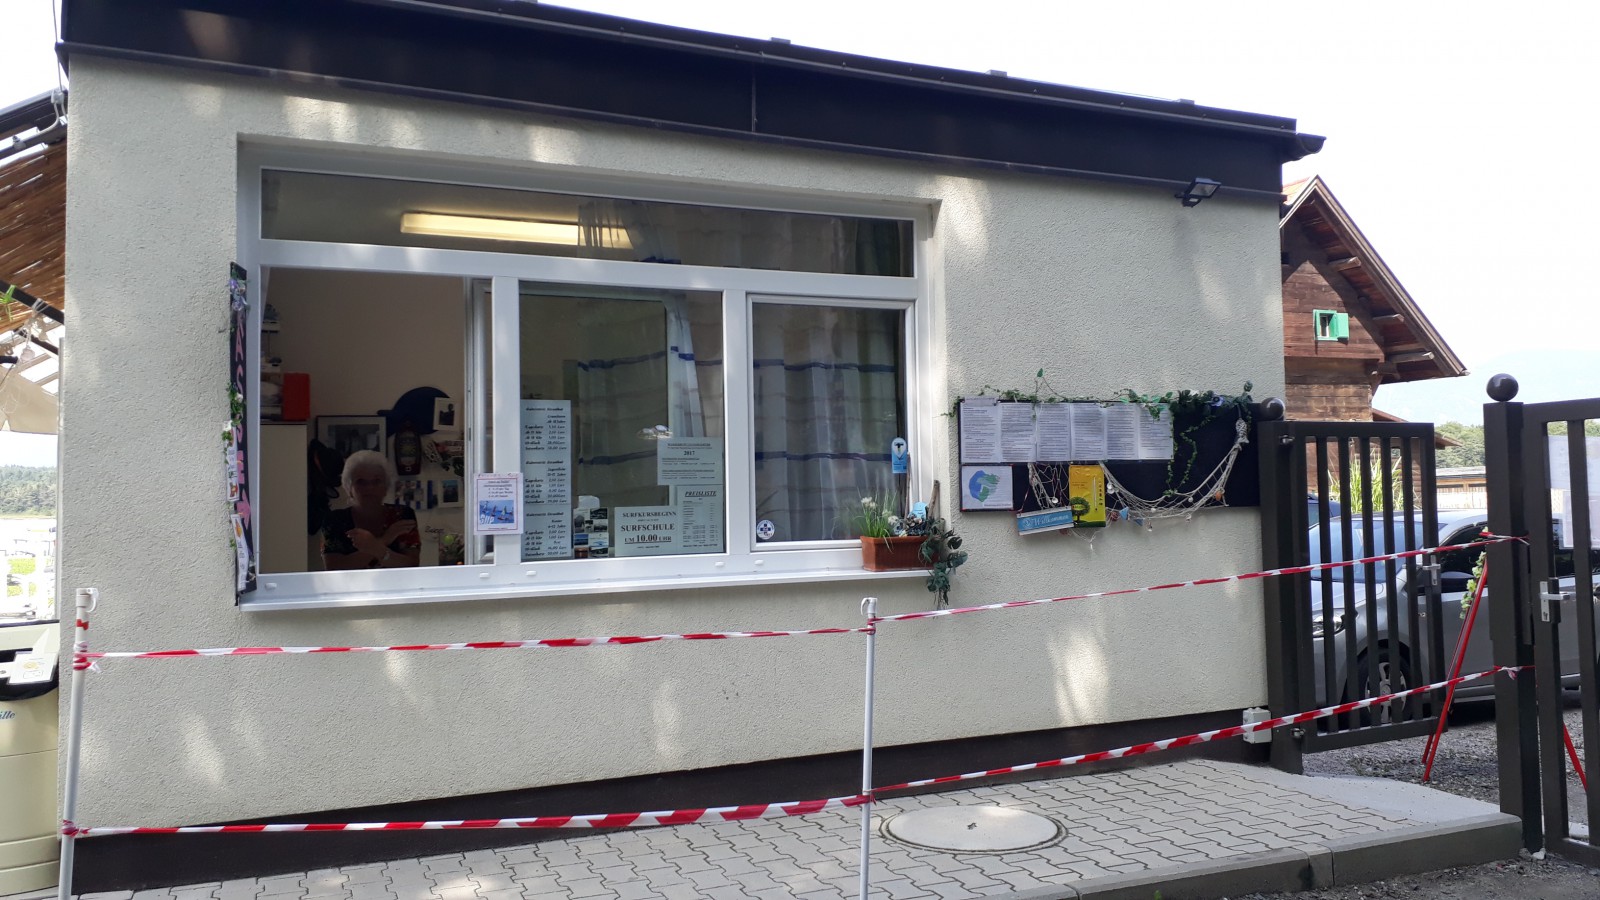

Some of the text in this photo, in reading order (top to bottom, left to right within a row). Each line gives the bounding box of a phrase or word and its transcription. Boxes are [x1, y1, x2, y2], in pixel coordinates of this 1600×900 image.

[1032, 514, 1069, 526] Willkommen
[621, 523, 675, 532] SURFSCHULE
[636, 534, 658, 542] 10.00
